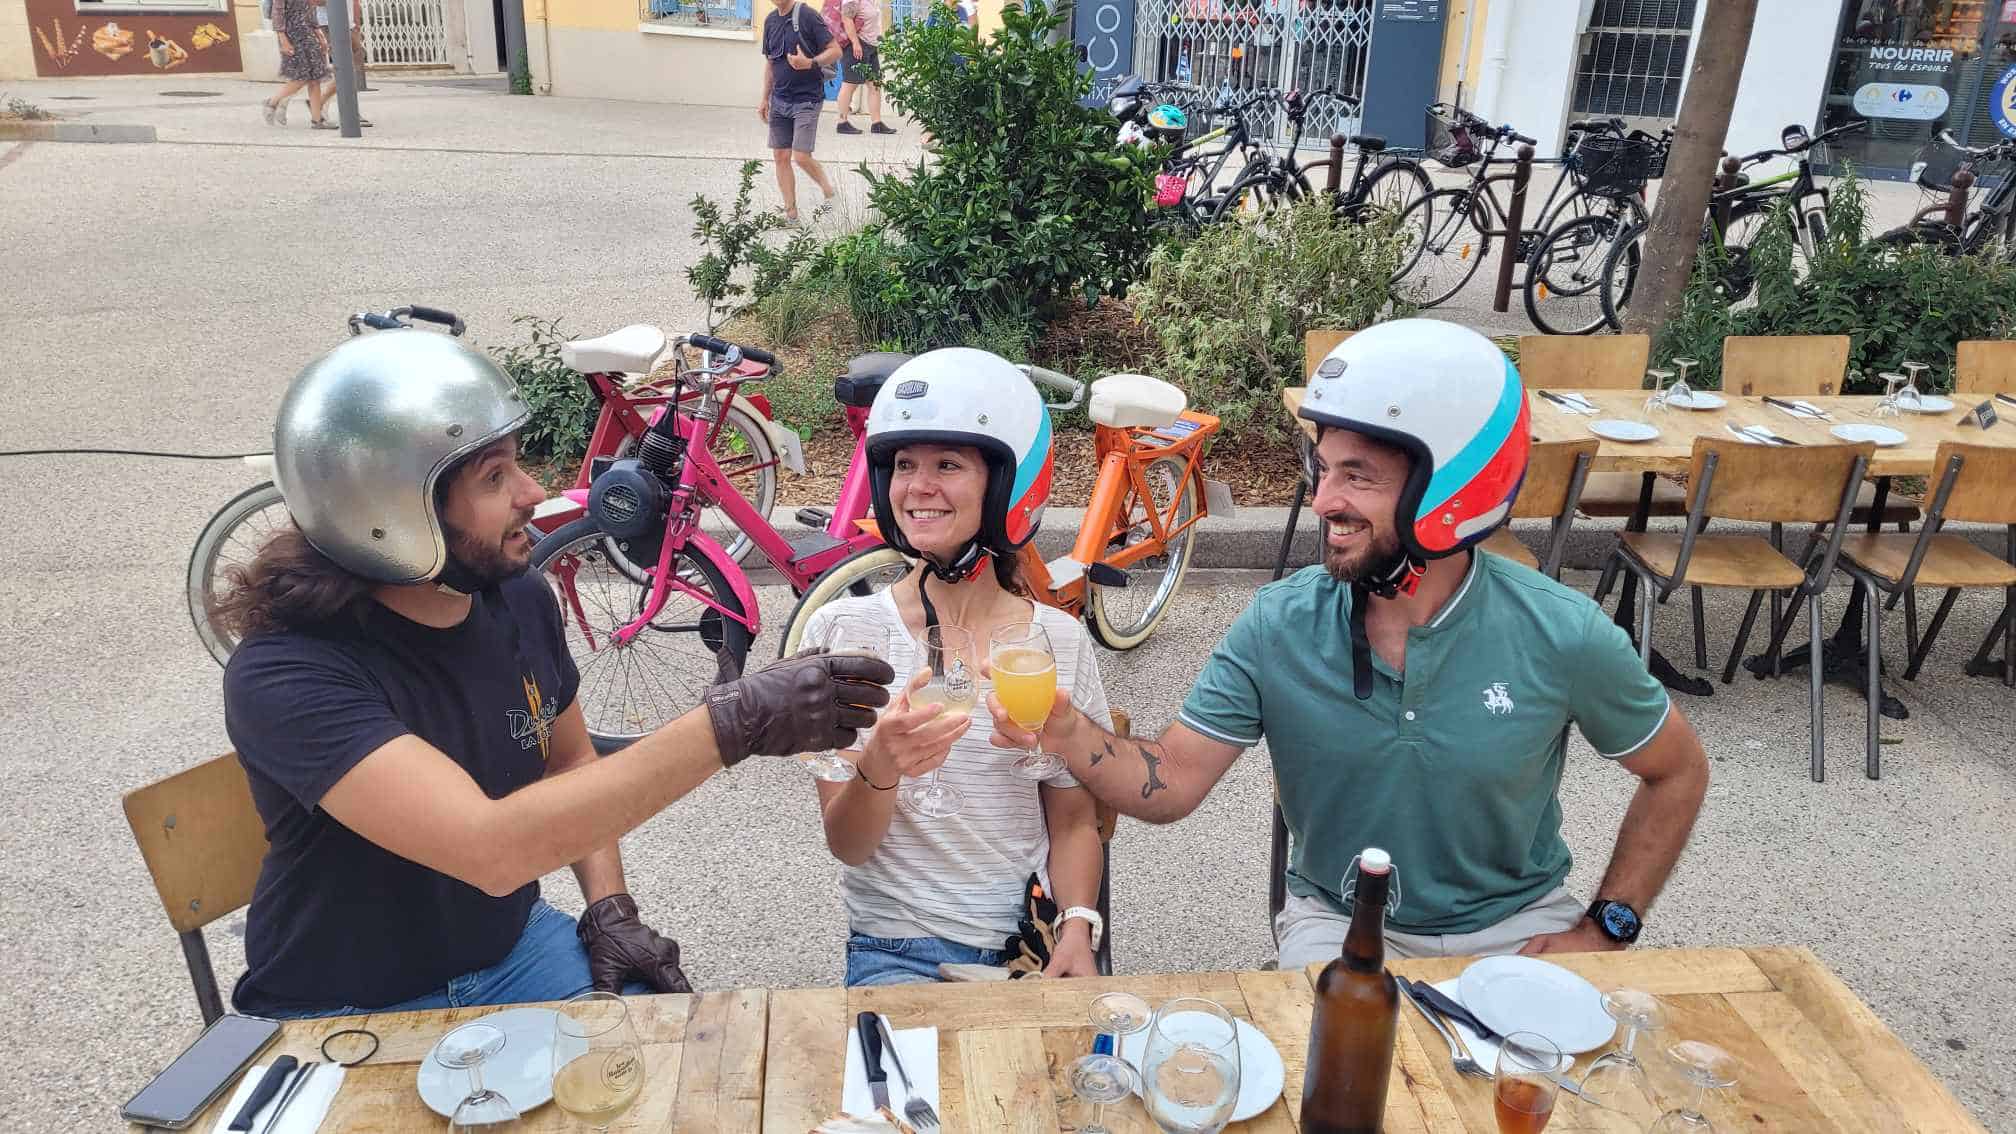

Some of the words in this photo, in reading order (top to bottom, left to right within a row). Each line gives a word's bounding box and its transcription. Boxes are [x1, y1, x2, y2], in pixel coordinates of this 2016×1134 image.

[1870, 46, 1953, 62] NOURRIR
[1869, 62, 1890, 71] TOUS
[1910, 63, 1949, 72] ESPOIRS
